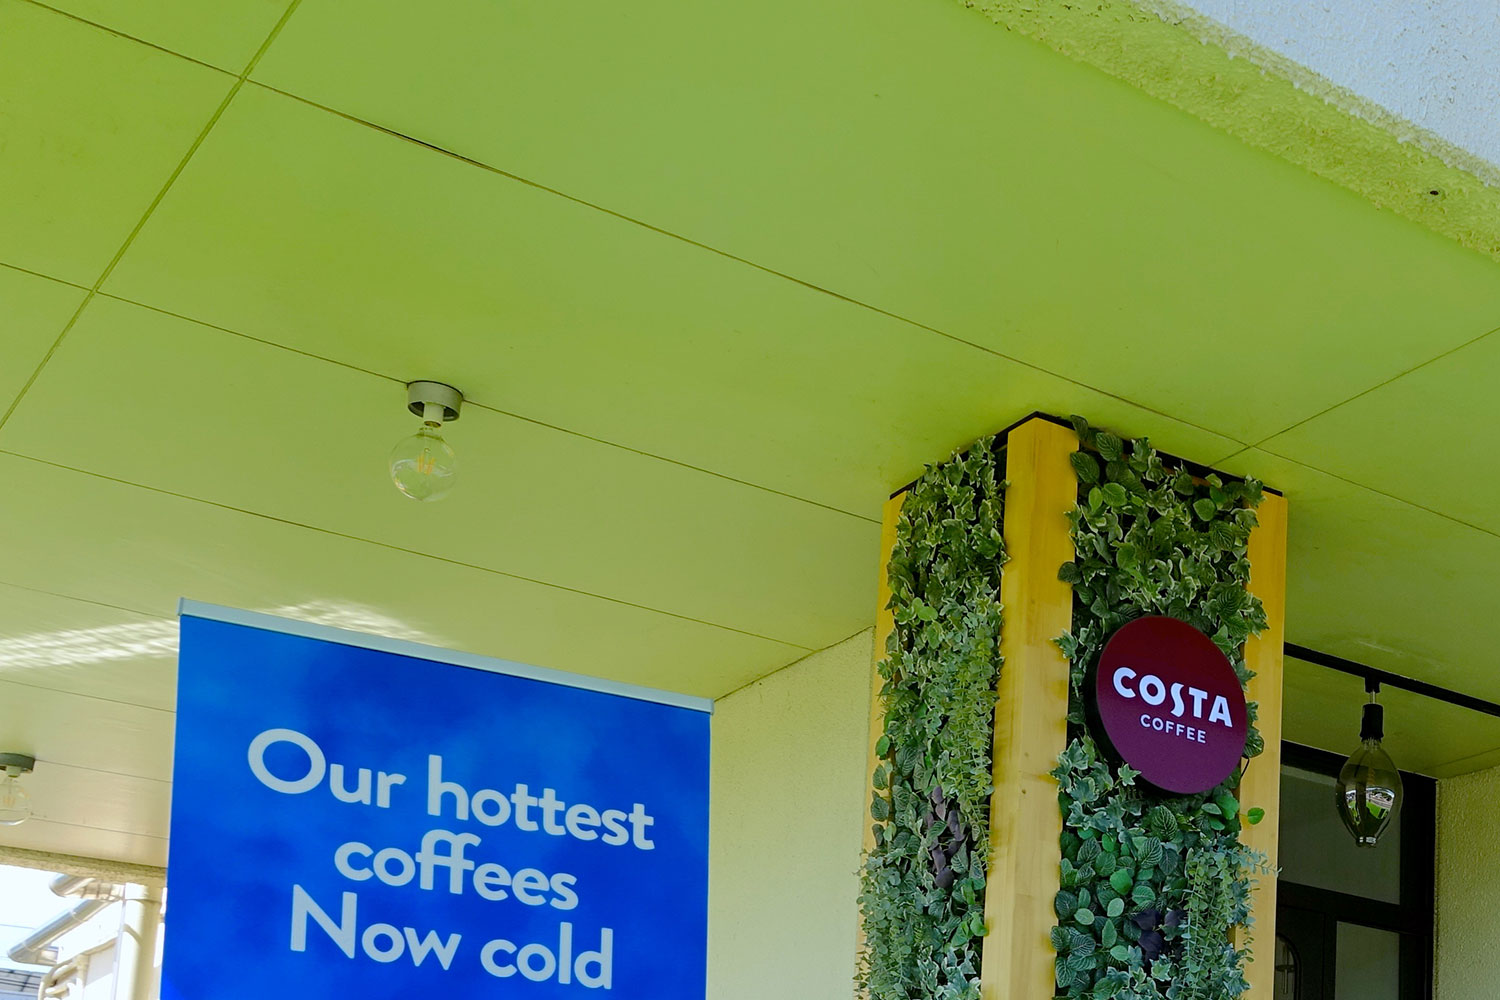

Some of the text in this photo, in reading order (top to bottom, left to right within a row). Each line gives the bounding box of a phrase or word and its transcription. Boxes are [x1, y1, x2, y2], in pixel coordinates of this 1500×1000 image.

[1113, 667, 1233, 728] COSTA
[1140, 714, 1206, 744] COFFEE
[248, 728, 655, 850] Our hottest
[334, 829, 579, 911] coffees
[290, 884, 613, 990] Now cold
